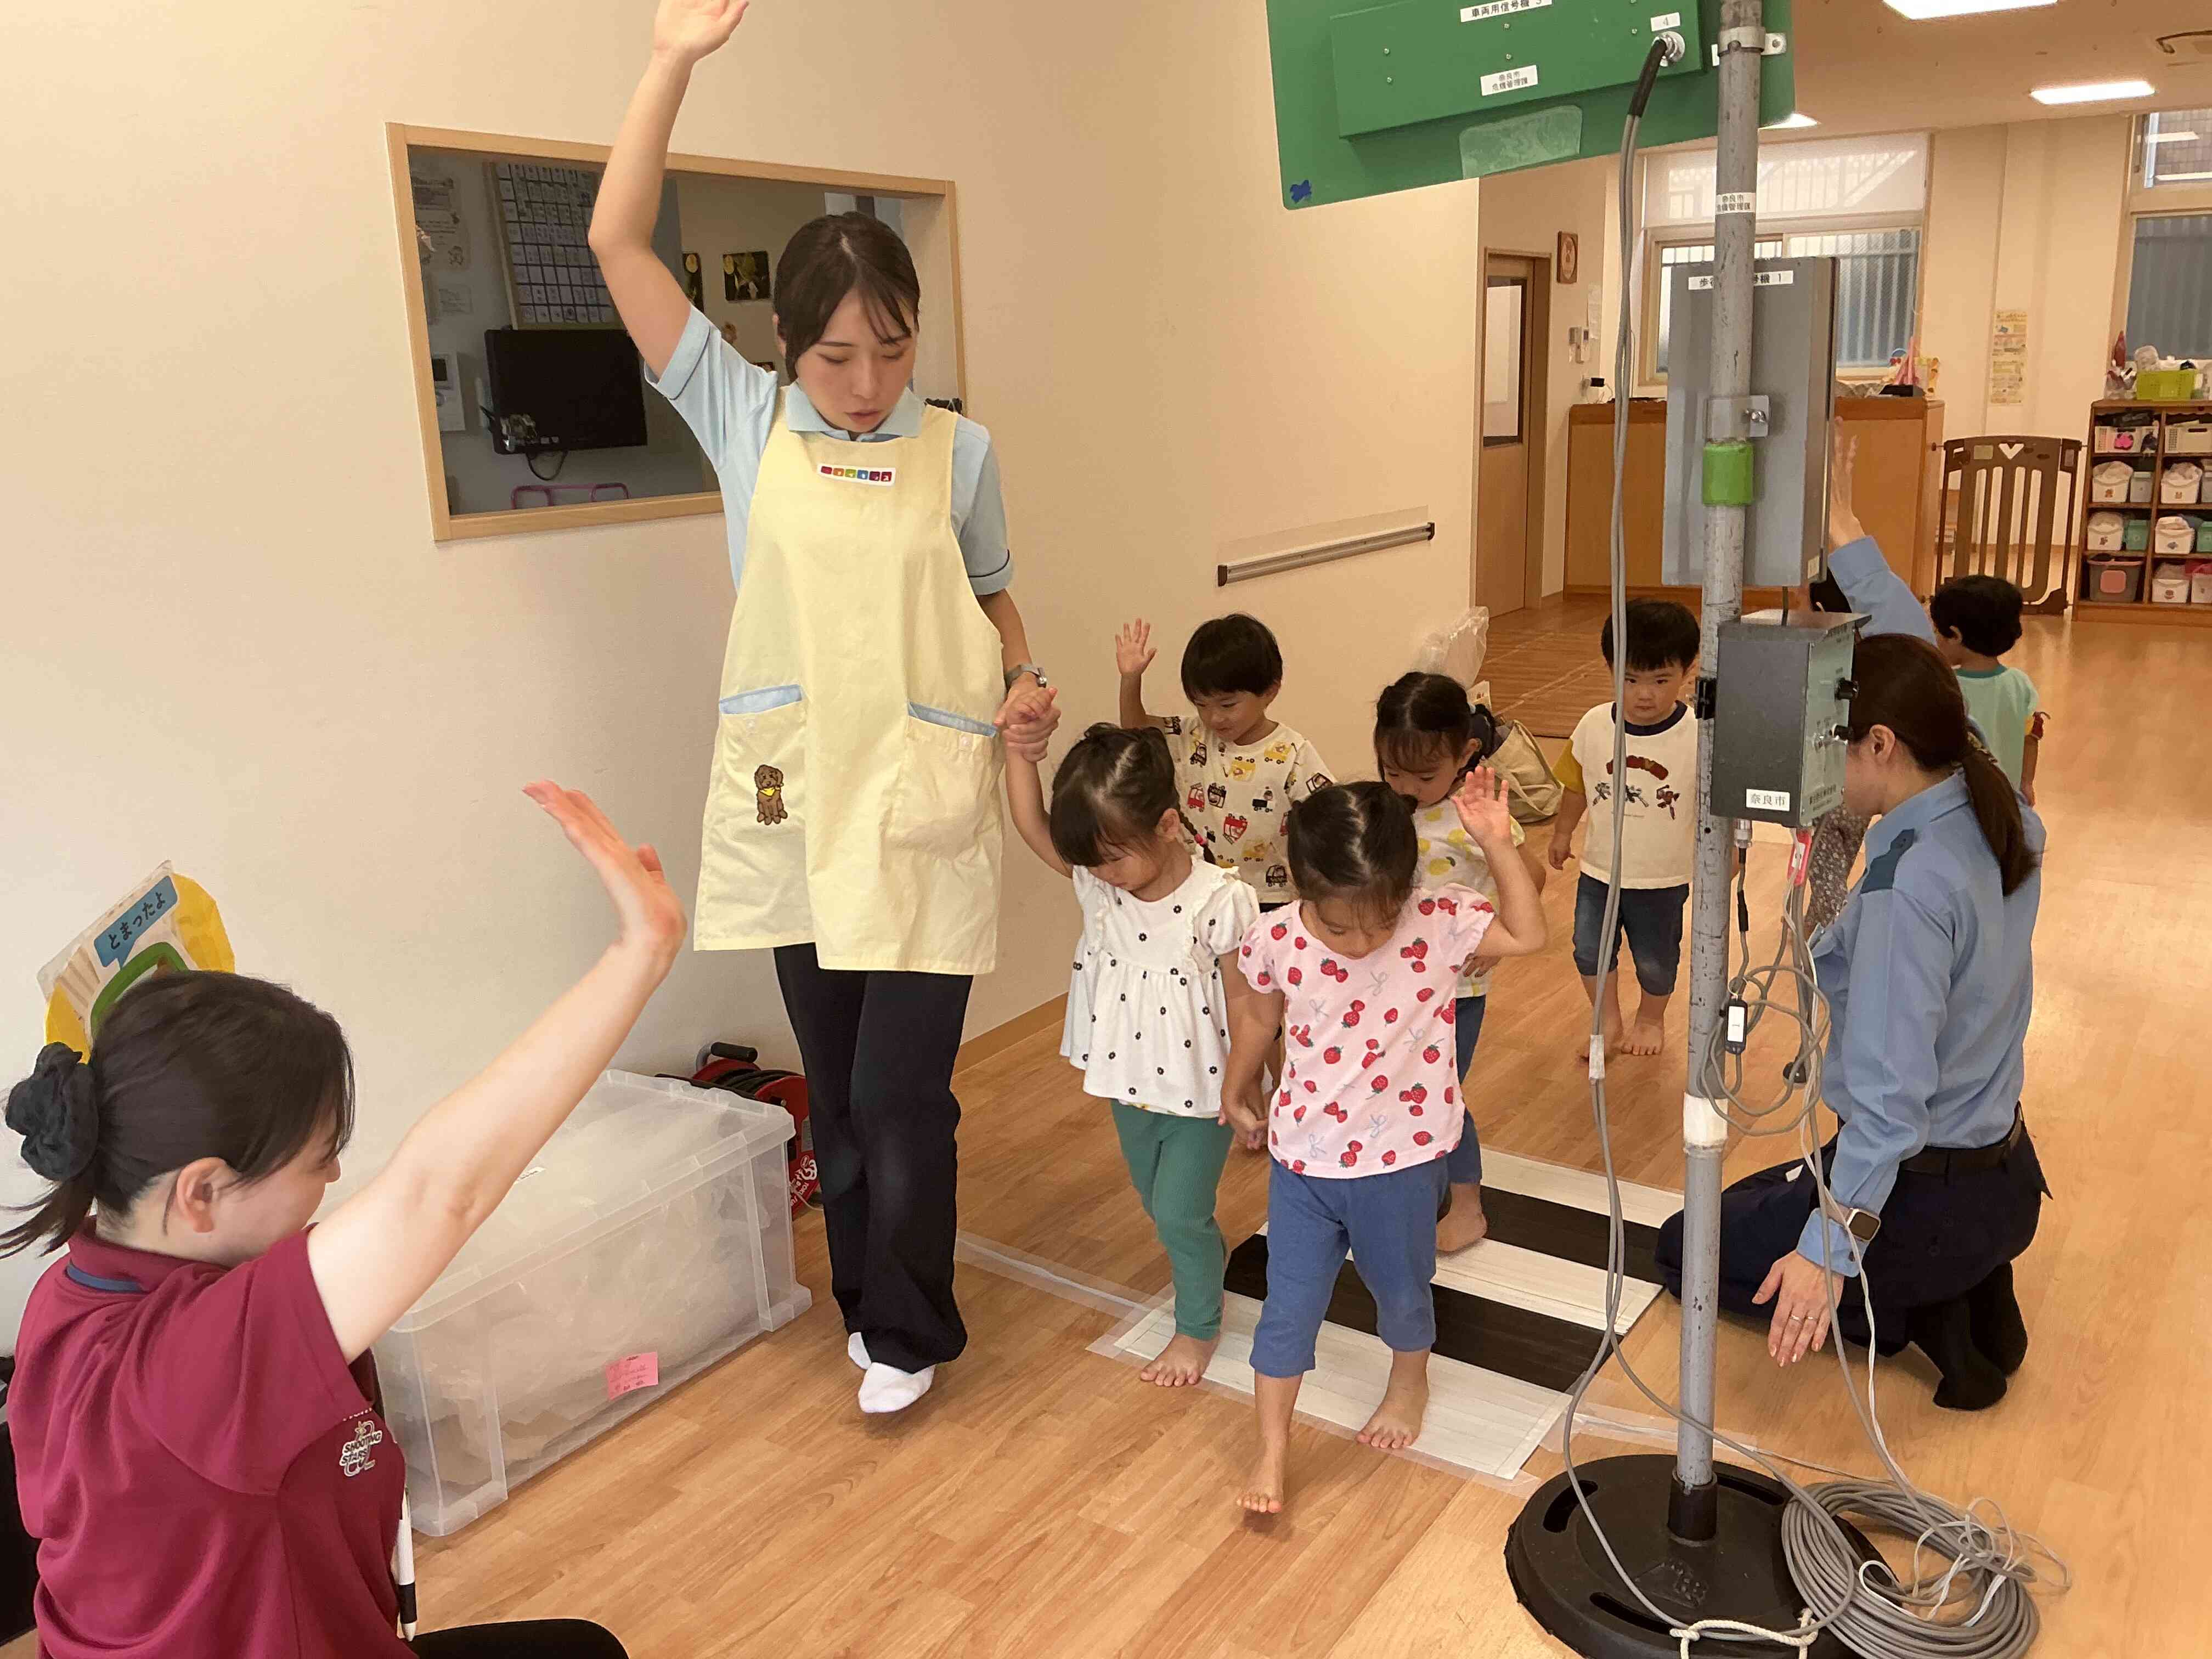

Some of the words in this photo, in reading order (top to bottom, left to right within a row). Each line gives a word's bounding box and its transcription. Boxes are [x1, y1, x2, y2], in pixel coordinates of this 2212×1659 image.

[1471, 0, 1530, 18] 車両用信号機
[1750, 793, 1786, 807] 奈良市
[108, 891, 166, 950] とまったよ
